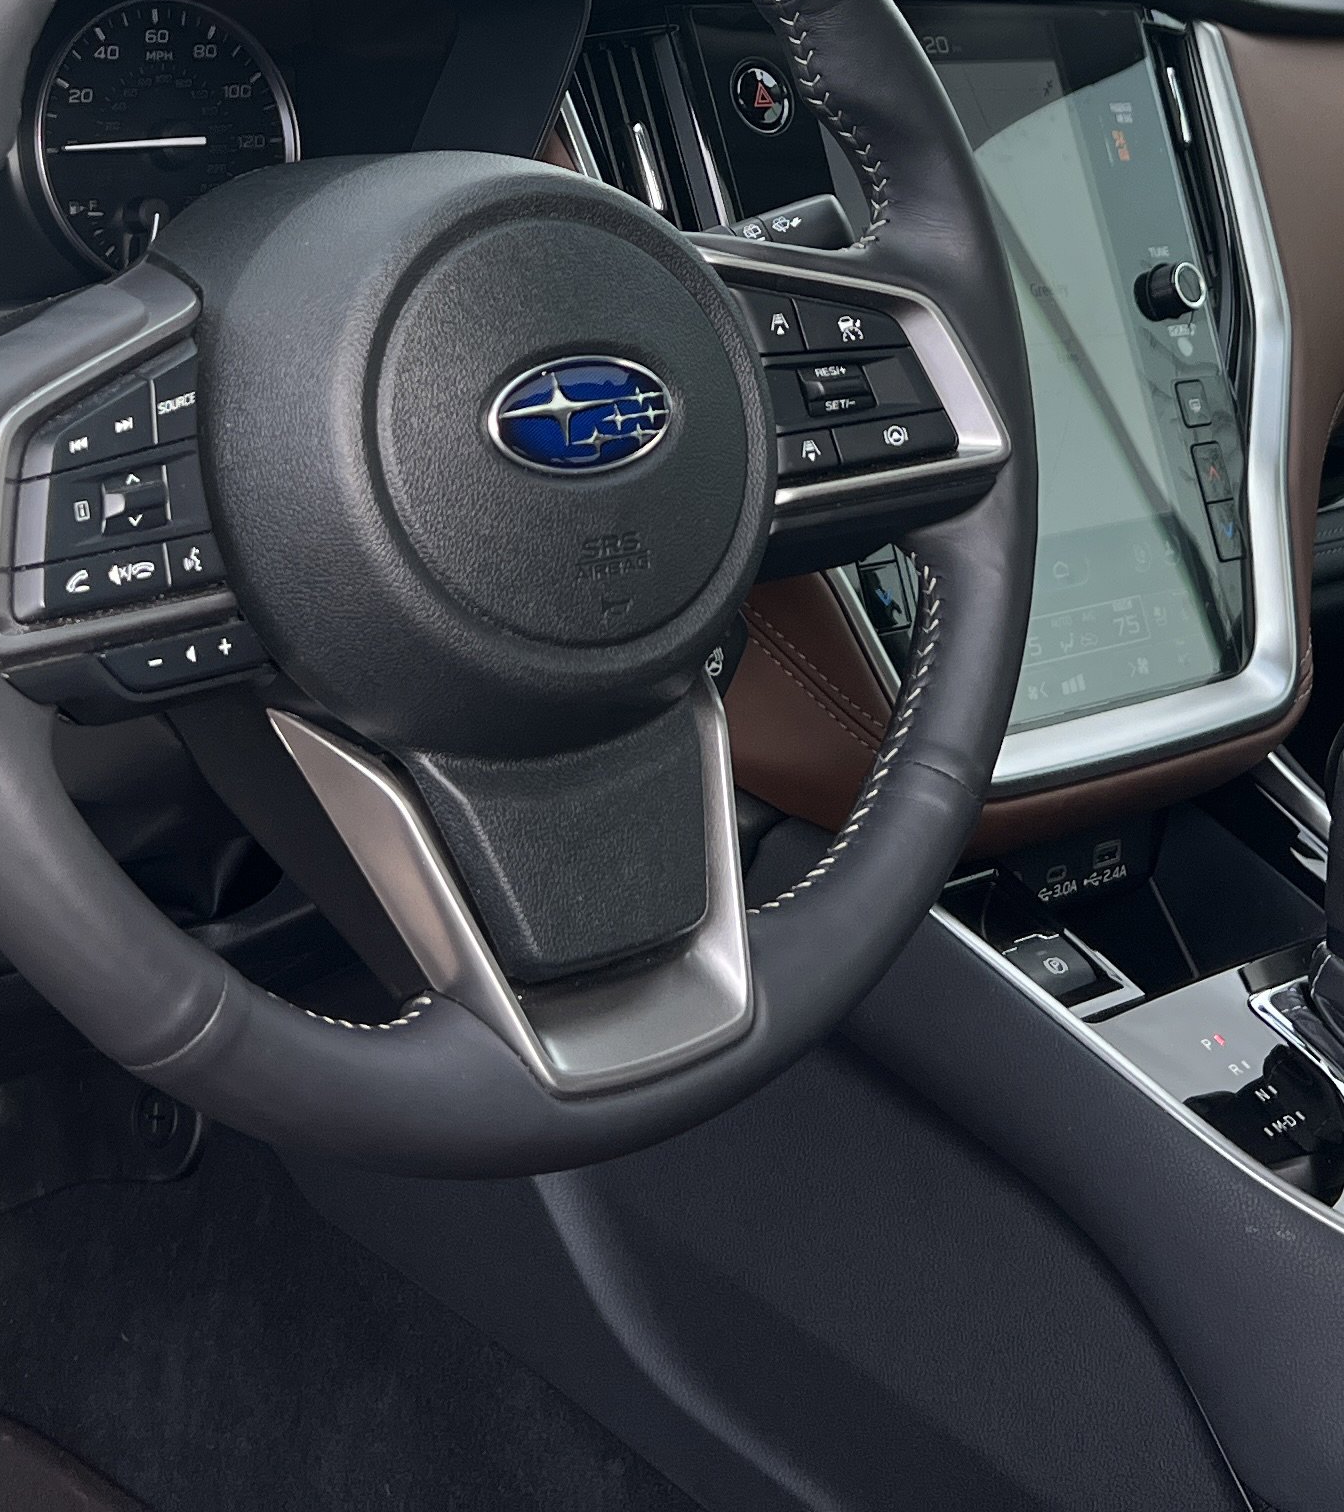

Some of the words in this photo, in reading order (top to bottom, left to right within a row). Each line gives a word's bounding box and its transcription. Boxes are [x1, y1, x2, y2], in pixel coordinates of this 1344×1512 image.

[144, 29, 169, 44] 60
[94, 45, 120, 60] 40
[145, 50, 173, 62] MPH
[193, 44, 217, 59] 80
[68, 88, 93, 104] 20
[224, 84, 252, 99] 100
[238, 134, 265, 149] 120
[157, 391, 196, 415] SOURCE
[582, 531, 641, 560] SRS
[577, 555, 650, 582] AIRBAG
[1113, 615, 1141, 637] 75
[1200, 1038, 1212, 1050] P
[1227, 1063, 1244, 1076] R
[1254, 1088, 1271, 1102] N
